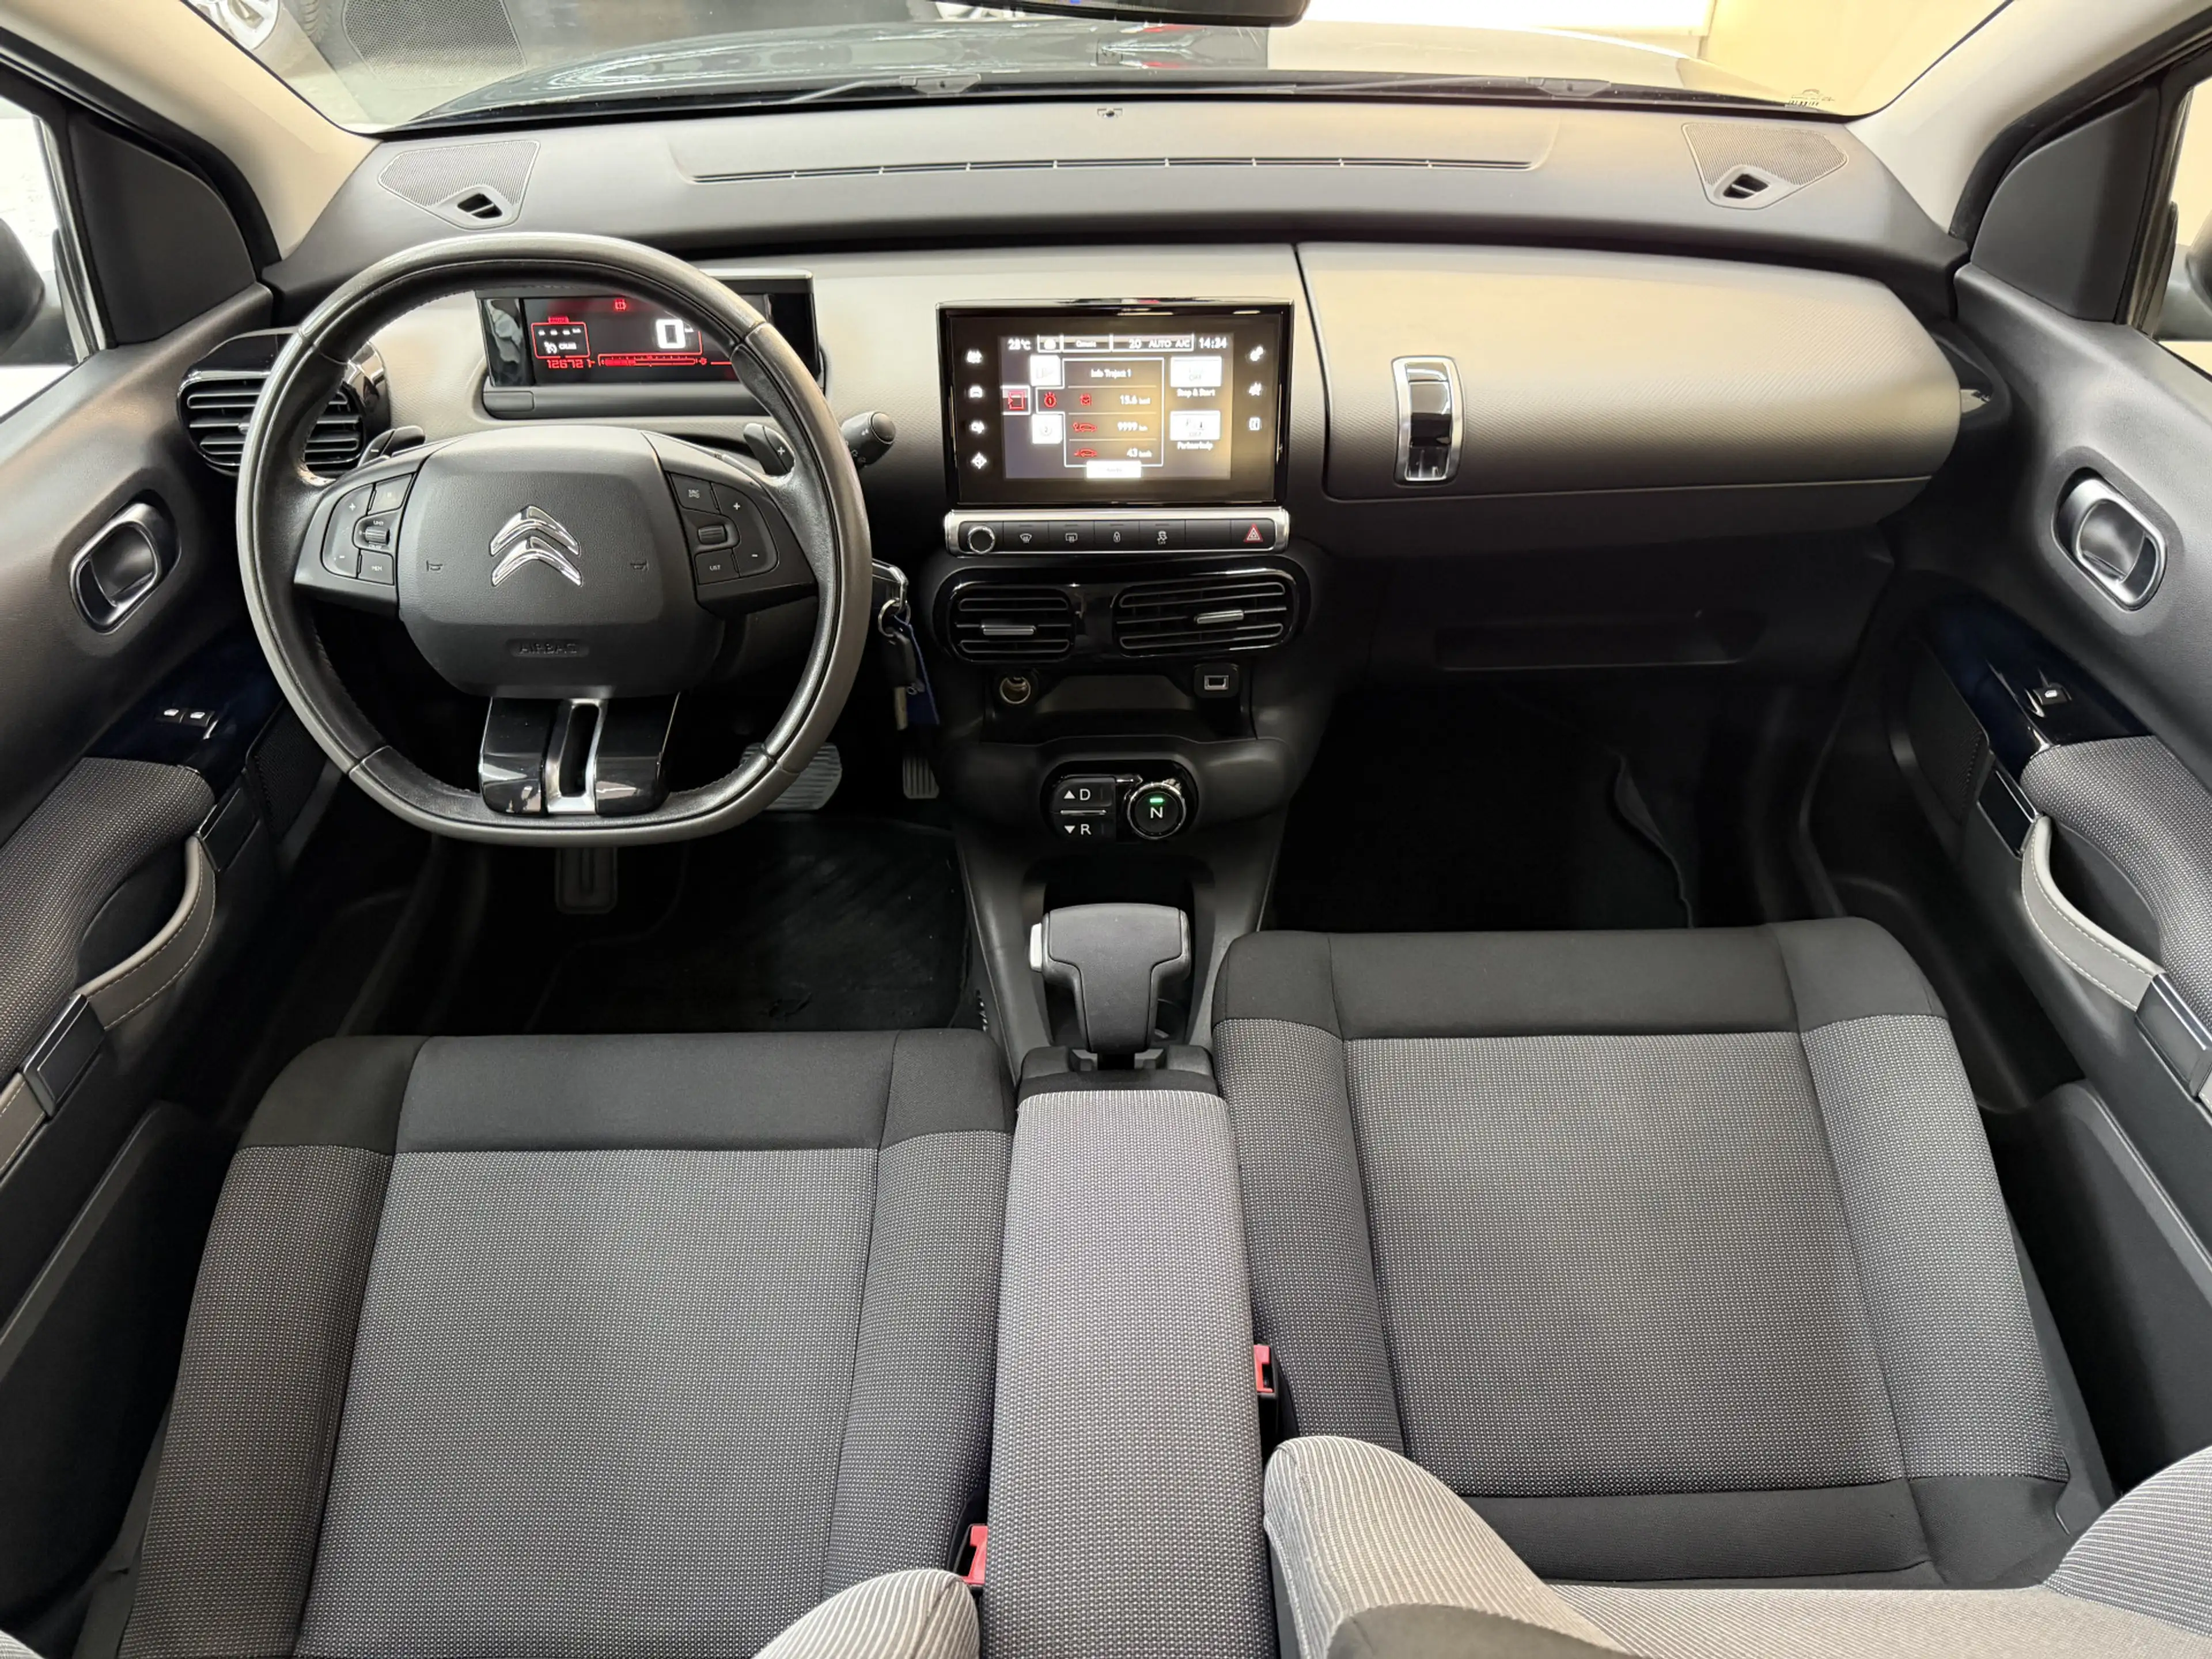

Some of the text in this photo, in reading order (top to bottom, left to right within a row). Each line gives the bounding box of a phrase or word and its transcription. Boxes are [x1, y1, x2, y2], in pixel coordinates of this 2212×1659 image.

[656, 319, 686, 349] 0
[1128, 338, 1142, 349] 20
[1149, 339, 1172, 348] AUTO
[1079, 789, 1091, 801] D
[1150, 806, 1164, 819] N
[1080, 824, 1092, 835] R
